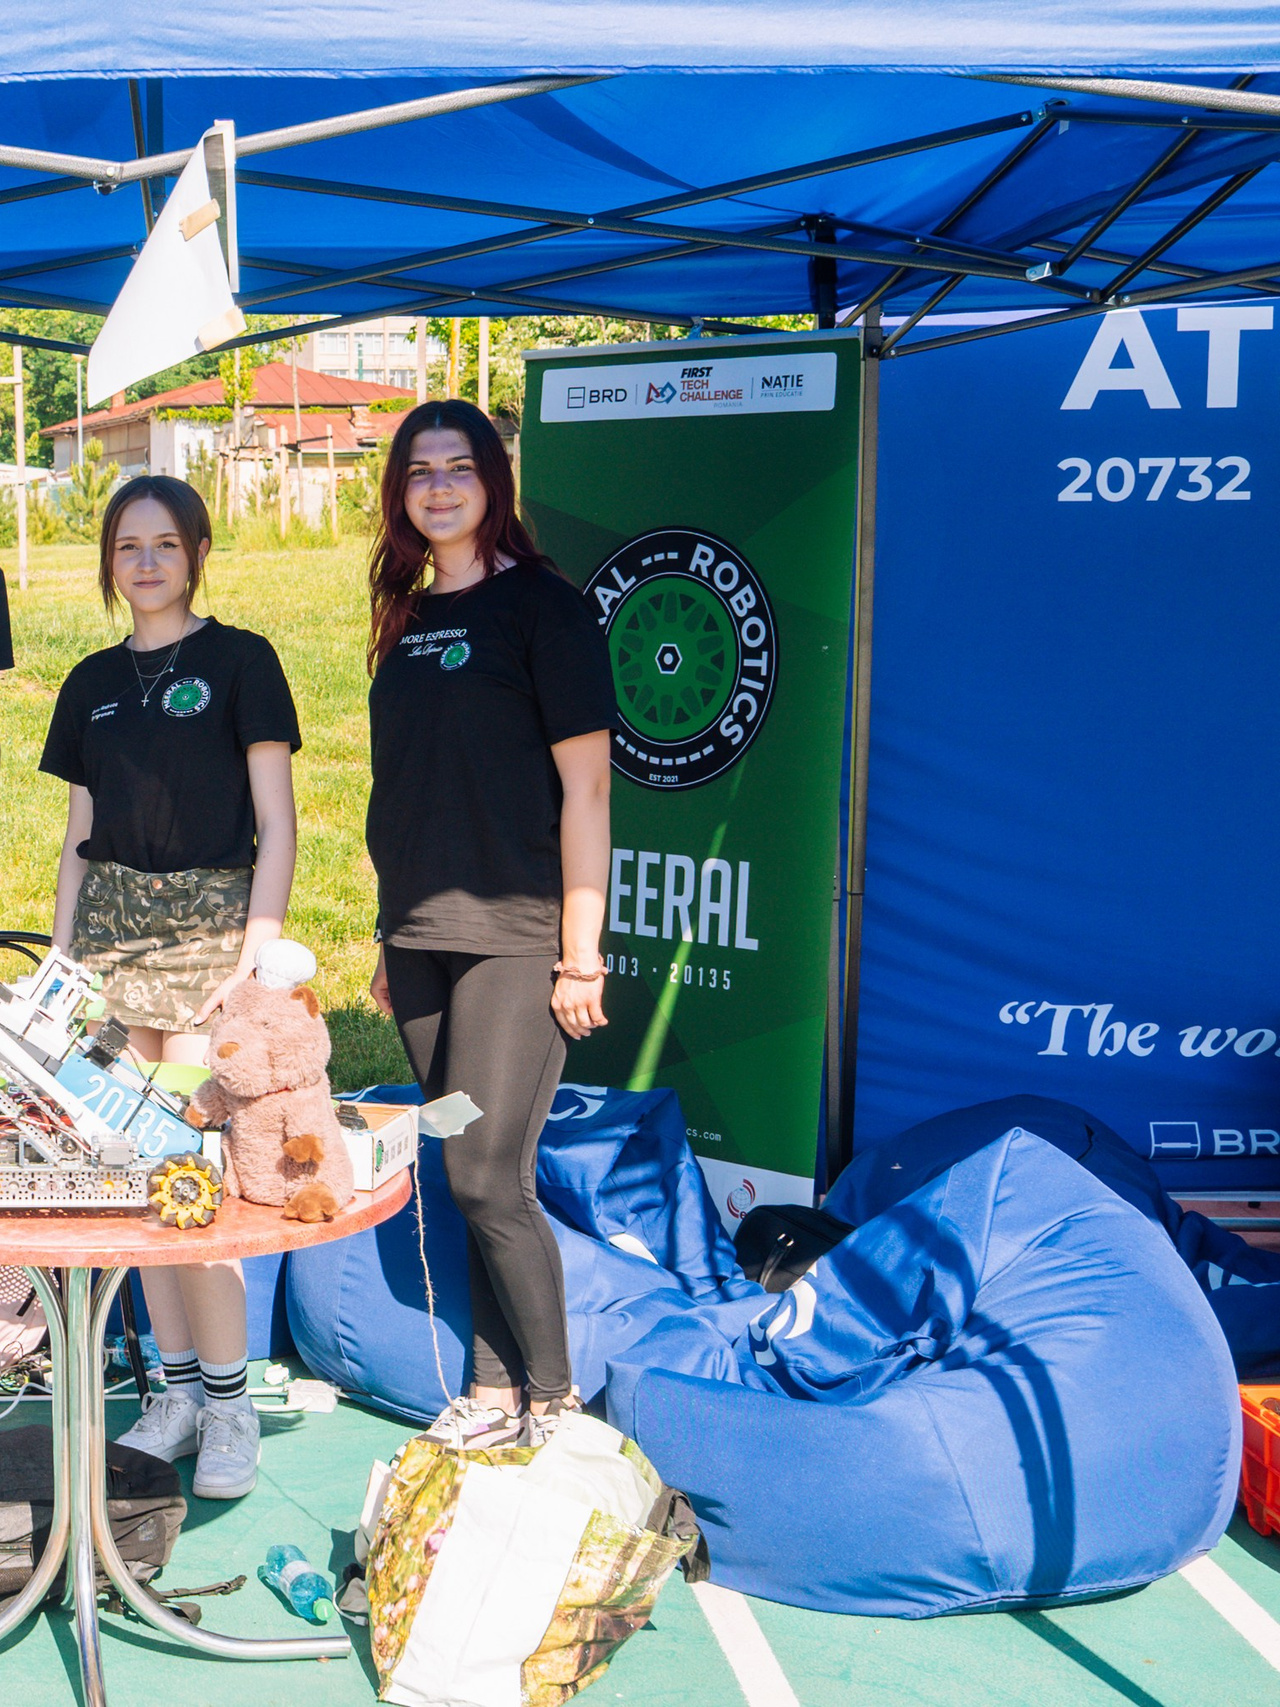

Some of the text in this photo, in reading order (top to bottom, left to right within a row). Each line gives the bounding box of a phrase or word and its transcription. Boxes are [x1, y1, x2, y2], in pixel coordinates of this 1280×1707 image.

[681, 366, 714, 378] FIRST
[1060, 306, 1274, 410] AT
[589, 388, 628, 403] BRD
[680, 379, 709, 390] TECH
[680, 389, 743, 402] CHALLENGE
[1057, 456, 1251, 502] 20732
[399, 628, 468, 645] MORE ESPRESSO
[689, 543, 768, 746] ROBOTICS
[193, 679, 209, 711] ROBOTICS
[649, 773, 678, 783] EST 2021
[609, 848, 759, 951] EERAL
[606, 953, 731, 990] 003 20135
[1178, 1025, 1280, 1057] wo
[79, 1074, 177, 1157] 20135
[685, 1128, 721, 1141] cs.com
[1212, 1129, 1280, 1156] BR
